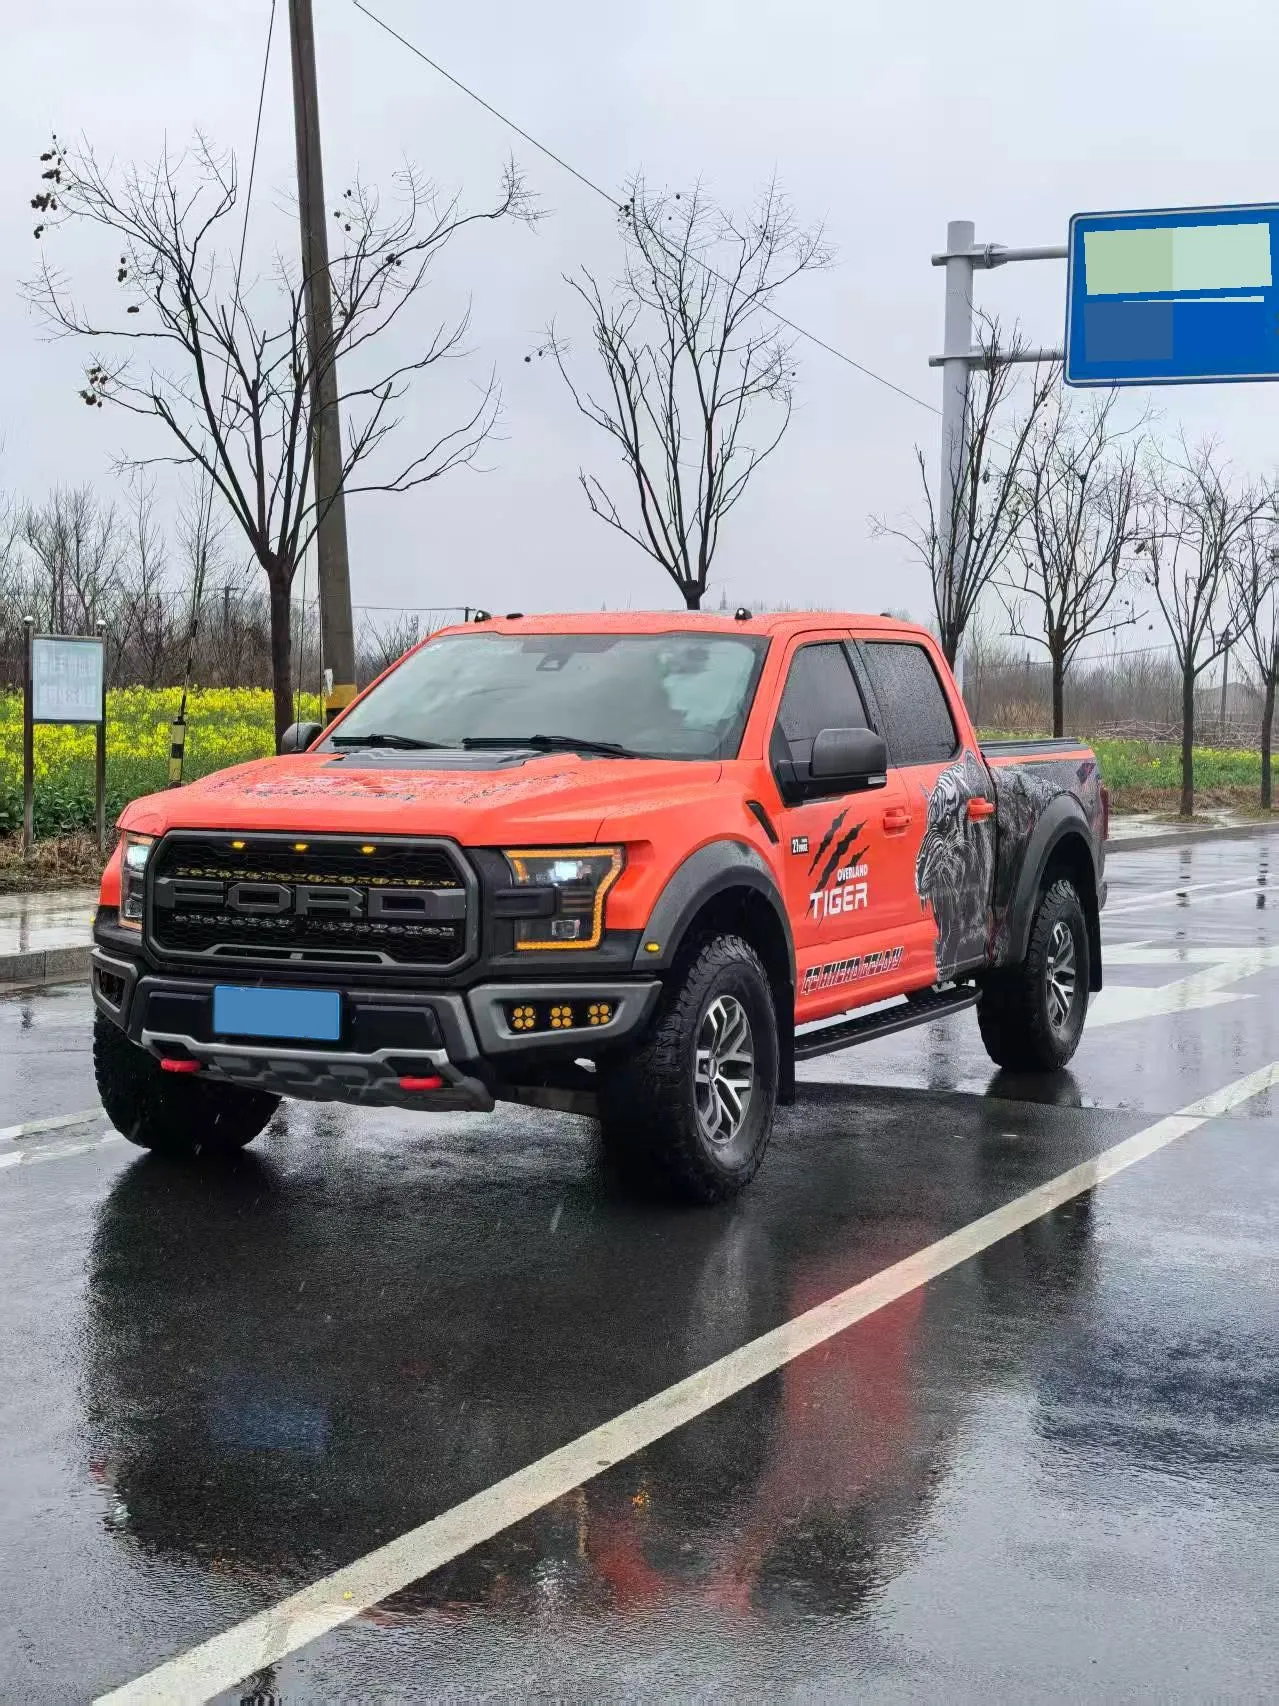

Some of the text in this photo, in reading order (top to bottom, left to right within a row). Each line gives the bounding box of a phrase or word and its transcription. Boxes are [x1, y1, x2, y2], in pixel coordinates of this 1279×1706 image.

[837, 864, 868, 881] OVERLAND
[155, 877, 466, 919] FORD
[809, 882, 868, 919] TIGER
